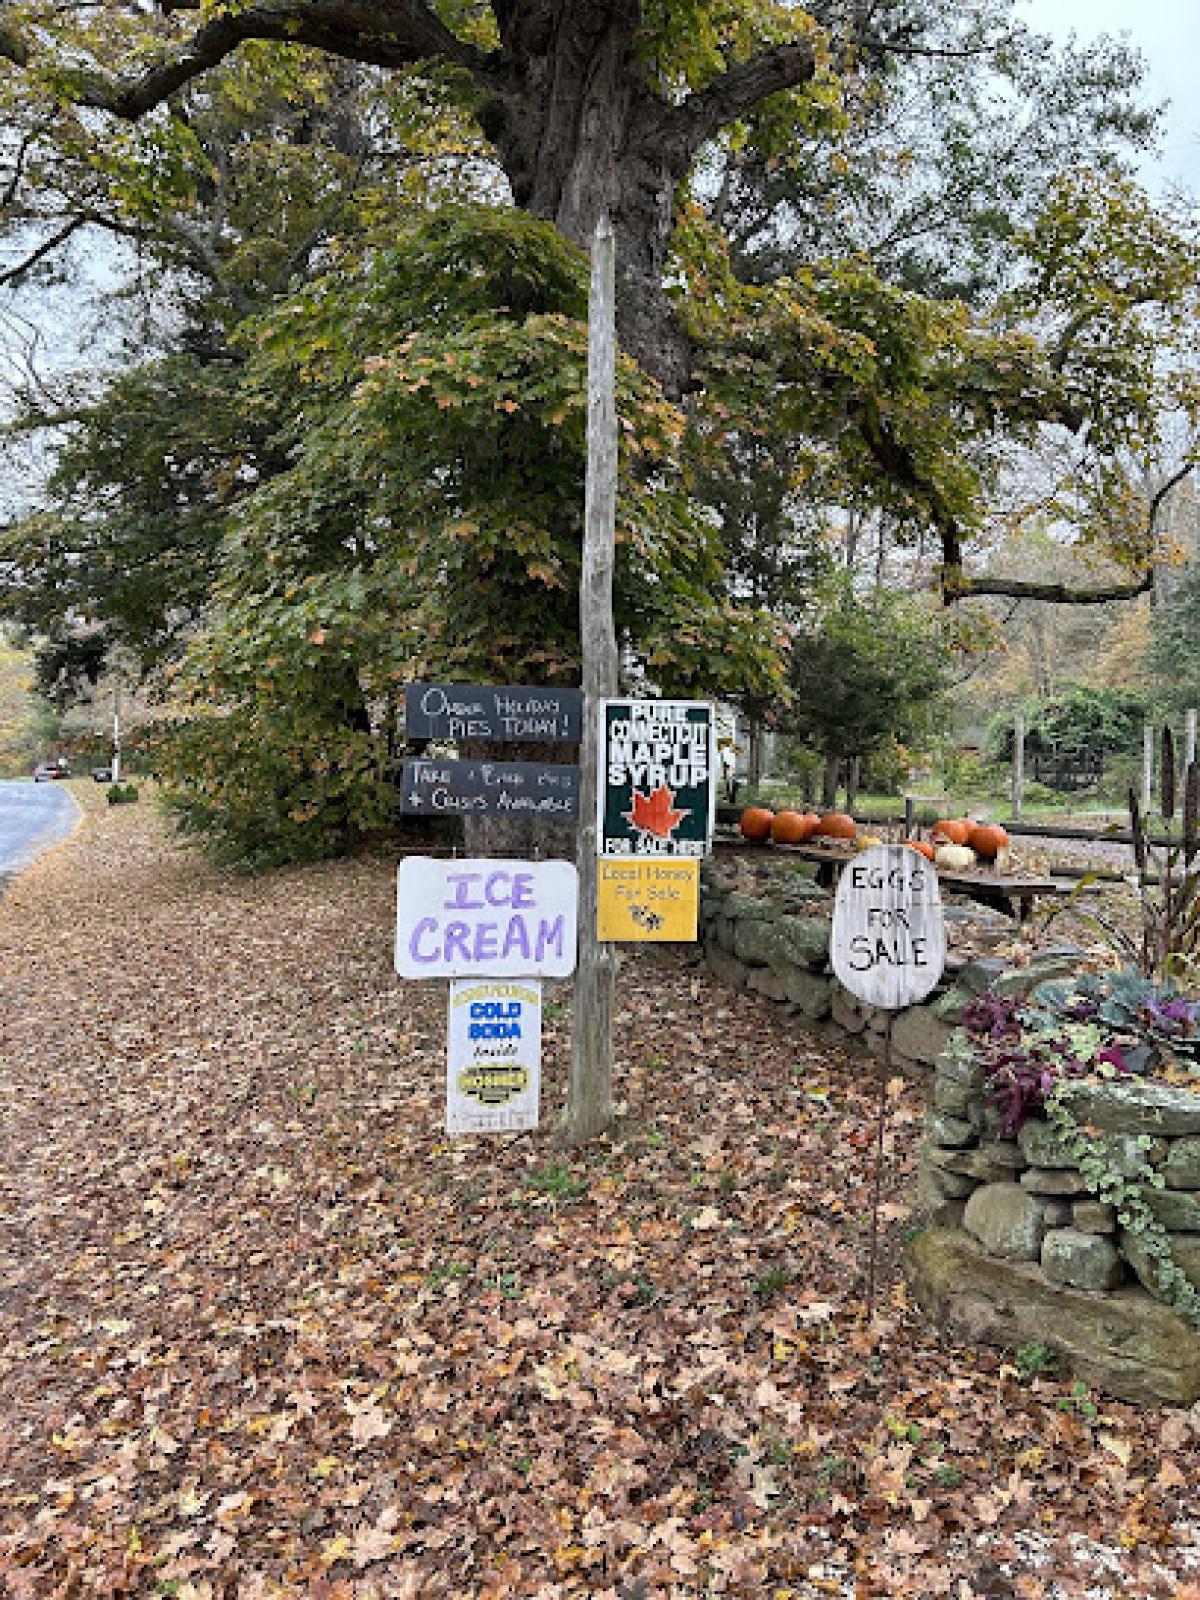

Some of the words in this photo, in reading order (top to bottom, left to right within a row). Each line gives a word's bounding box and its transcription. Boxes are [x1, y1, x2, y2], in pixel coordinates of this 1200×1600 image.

[631, 705, 688, 722] PURE
[447, 717, 492, 738] PIES
[610, 743, 708, 765] MAPLE
[608, 764, 708, 788] SYRUP
[605, 838, 631, 855] FOR
[637, 838, 669, 855] SALE
[602, 866, 642, 880] Local
[646, 866, 695, 884] Honey
[852, 867, 925, 892] EGGS
[443, 869, 537, 910] ICE
[614, 884, 642, 900] For
[646, 884, 681, 901] Sale
[867, 908, 910, 930] FOR
[408, 913, 566, 963] CREAM
[846, 935, 928, 971] SALE
[469, 1002, 522, 1019] COLD
[467, 1022, 522, 1040] SODA
